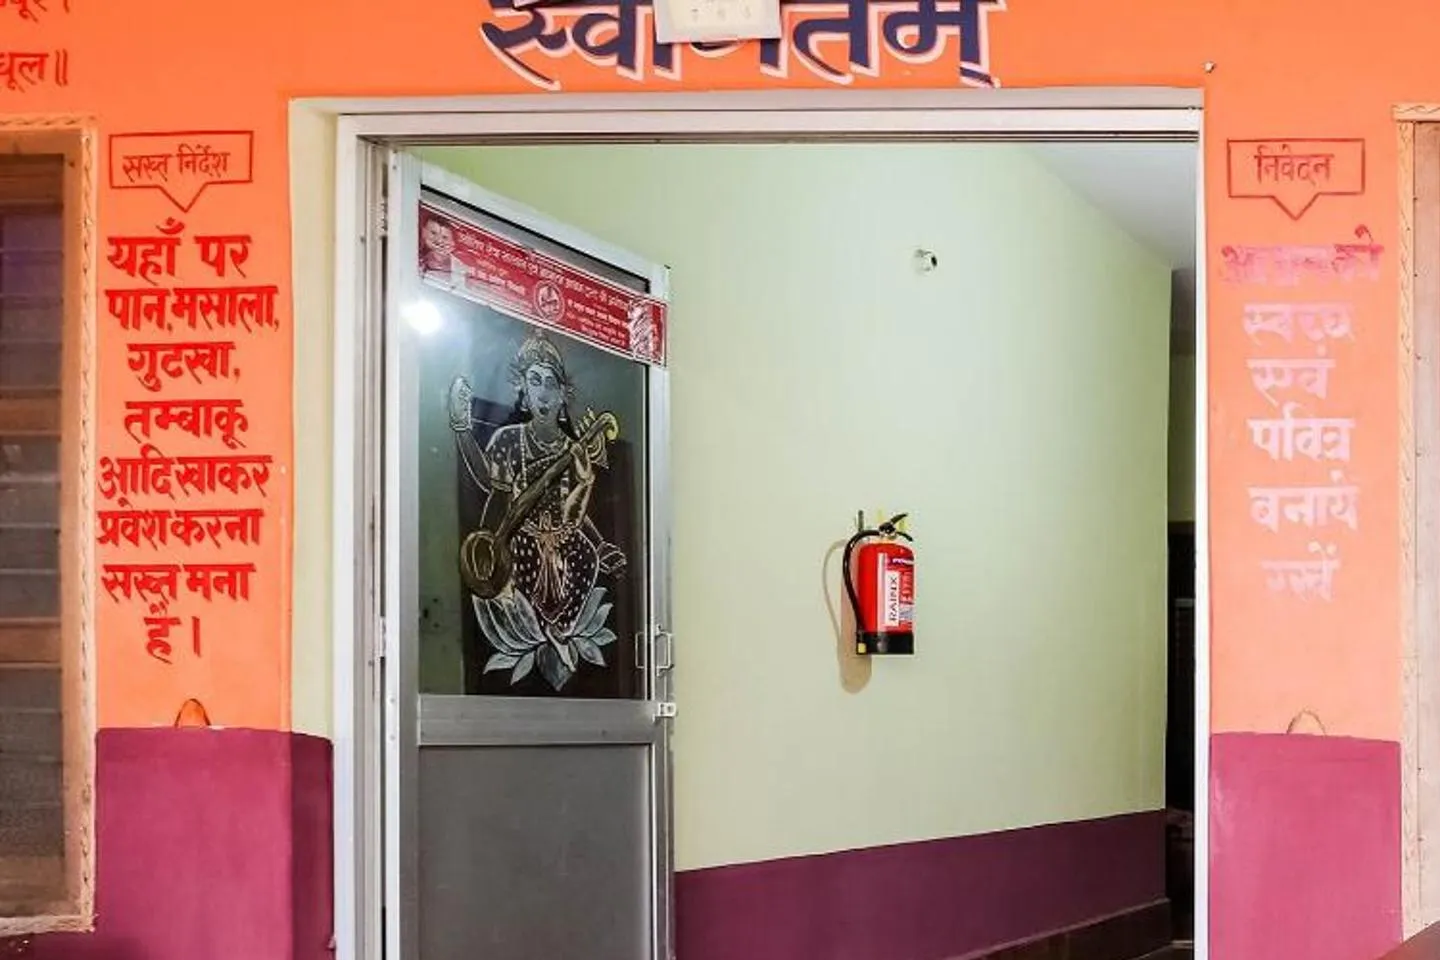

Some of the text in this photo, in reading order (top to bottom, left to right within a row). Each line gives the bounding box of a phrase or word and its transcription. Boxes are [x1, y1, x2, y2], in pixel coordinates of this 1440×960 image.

[122, 143, 231, 182] सख्त निर्देश
[1254, 143, 1334, 186] निवेदन
[107, 217, 252, 286] यहाँ पर
[105, 286, 279, 333] पान, मसाला,
[127, 341, 240, 392] गुटखा,
[124, 399, 249, 449] तम्बाकू
[97, 443, 272, 503] आदि खाकर
[96, 497, 264, 550] प्रवेश करना
[102, 562, 256, 604] सख्त मना
